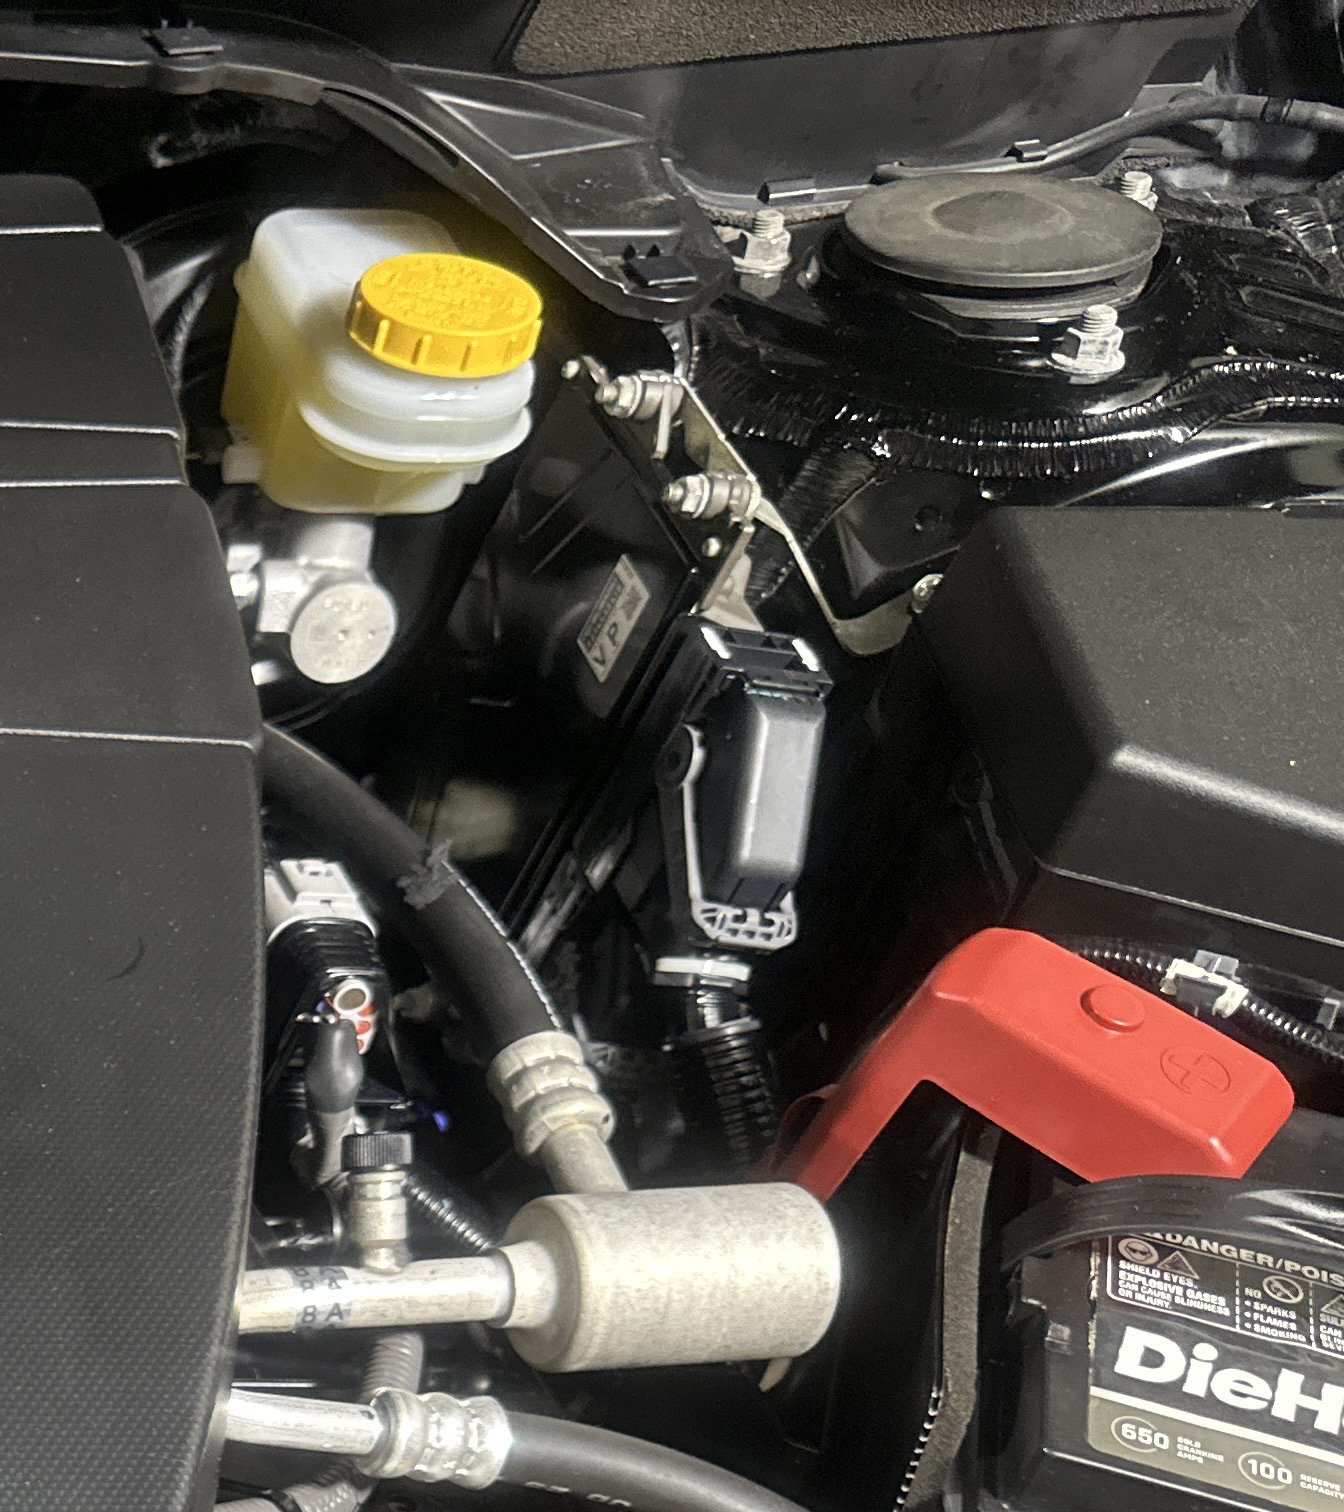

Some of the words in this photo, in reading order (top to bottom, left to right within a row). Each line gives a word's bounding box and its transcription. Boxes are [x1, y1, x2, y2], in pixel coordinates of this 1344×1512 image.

[1118, 1260, 1160, 1279] SHIELD
[1118, 1270, 1184, 1294] EXPLOSIVE
[1186, 1288, 1226, 1306] GASES
[1118, 1288, 1132, 1299] OR
[1118, 1280, 1138, 1292] CAN
[1141, 1285, 1171, 1300] CAUSE
[1174, 1294, 1230, 1317] BLINDNESS
[1253, 1302, 1296, 1321] SPARKS
[1253, 1312, 1297, 1331] FLAMES
[1253, 1324, 1306, 1342] SMOKING
[1121, 1423, 1169, 1449] 650
[1248, 1459, 1292, 1484] 100
